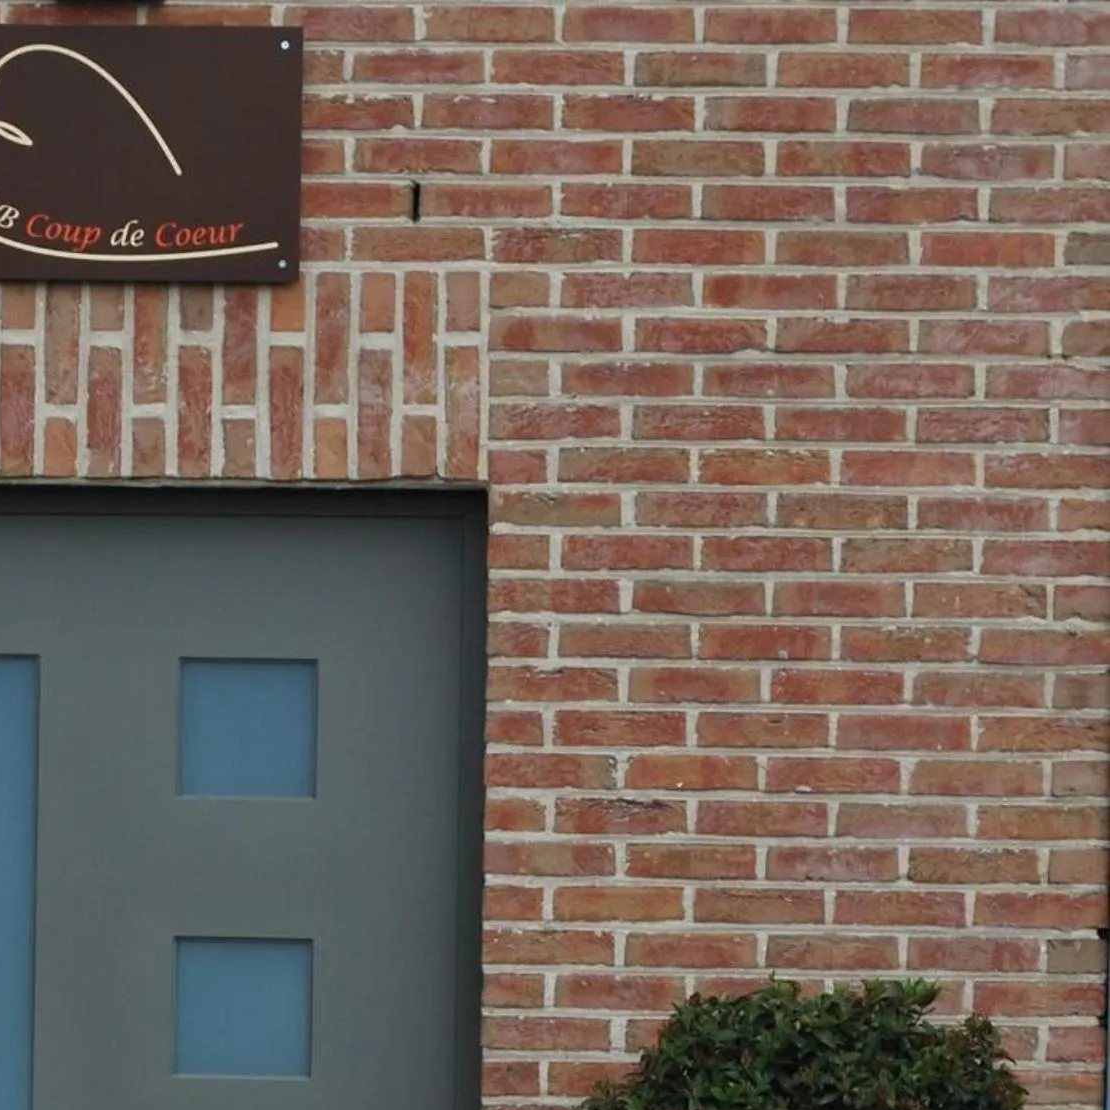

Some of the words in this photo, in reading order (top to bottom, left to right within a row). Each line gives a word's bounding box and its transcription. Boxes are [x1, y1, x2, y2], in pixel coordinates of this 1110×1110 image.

[25, 213, 102, 254] Coup
[109, 218, 145, 249] de
[154, 221, 245, 249] Coeur
